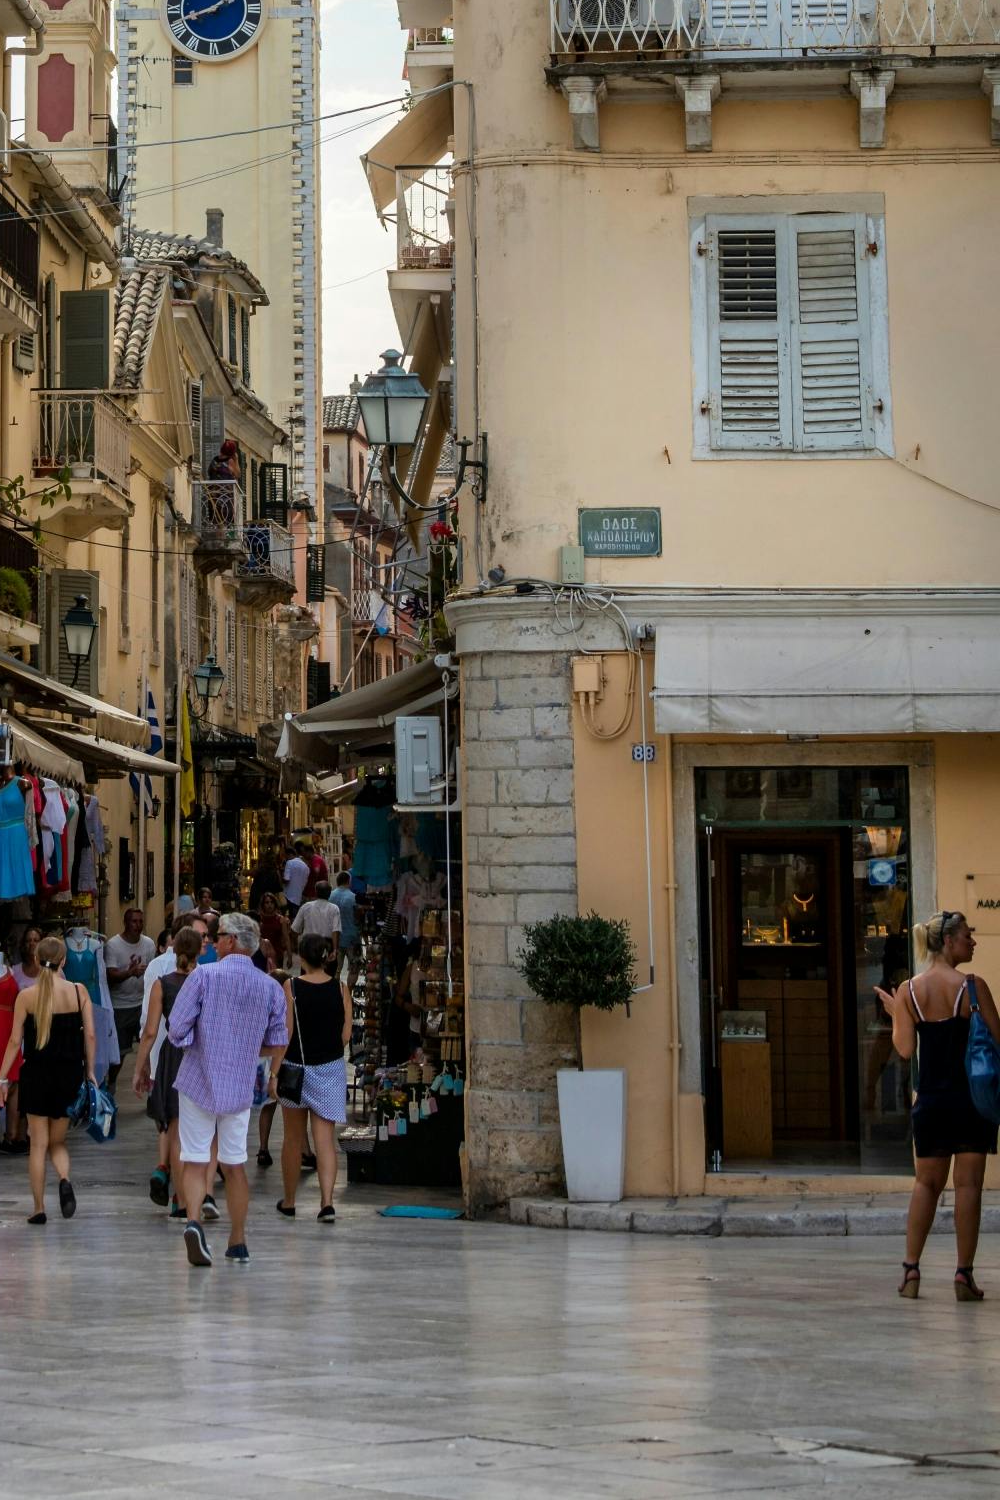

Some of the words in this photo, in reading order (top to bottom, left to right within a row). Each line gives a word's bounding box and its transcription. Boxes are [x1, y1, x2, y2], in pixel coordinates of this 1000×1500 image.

[167, 4, 181, 14] IX
[247, 3, 260, 14] III
[209, 42, 220, 55] VI
[231, 38, 240, 49] V
[602, 517, 638, 530] ΟΔΟΣ
[587, 531, 655, 543] ΚΑΠΟΔΙΣΤΡΙΟΥ
[633, 746, 654, 760] 88
